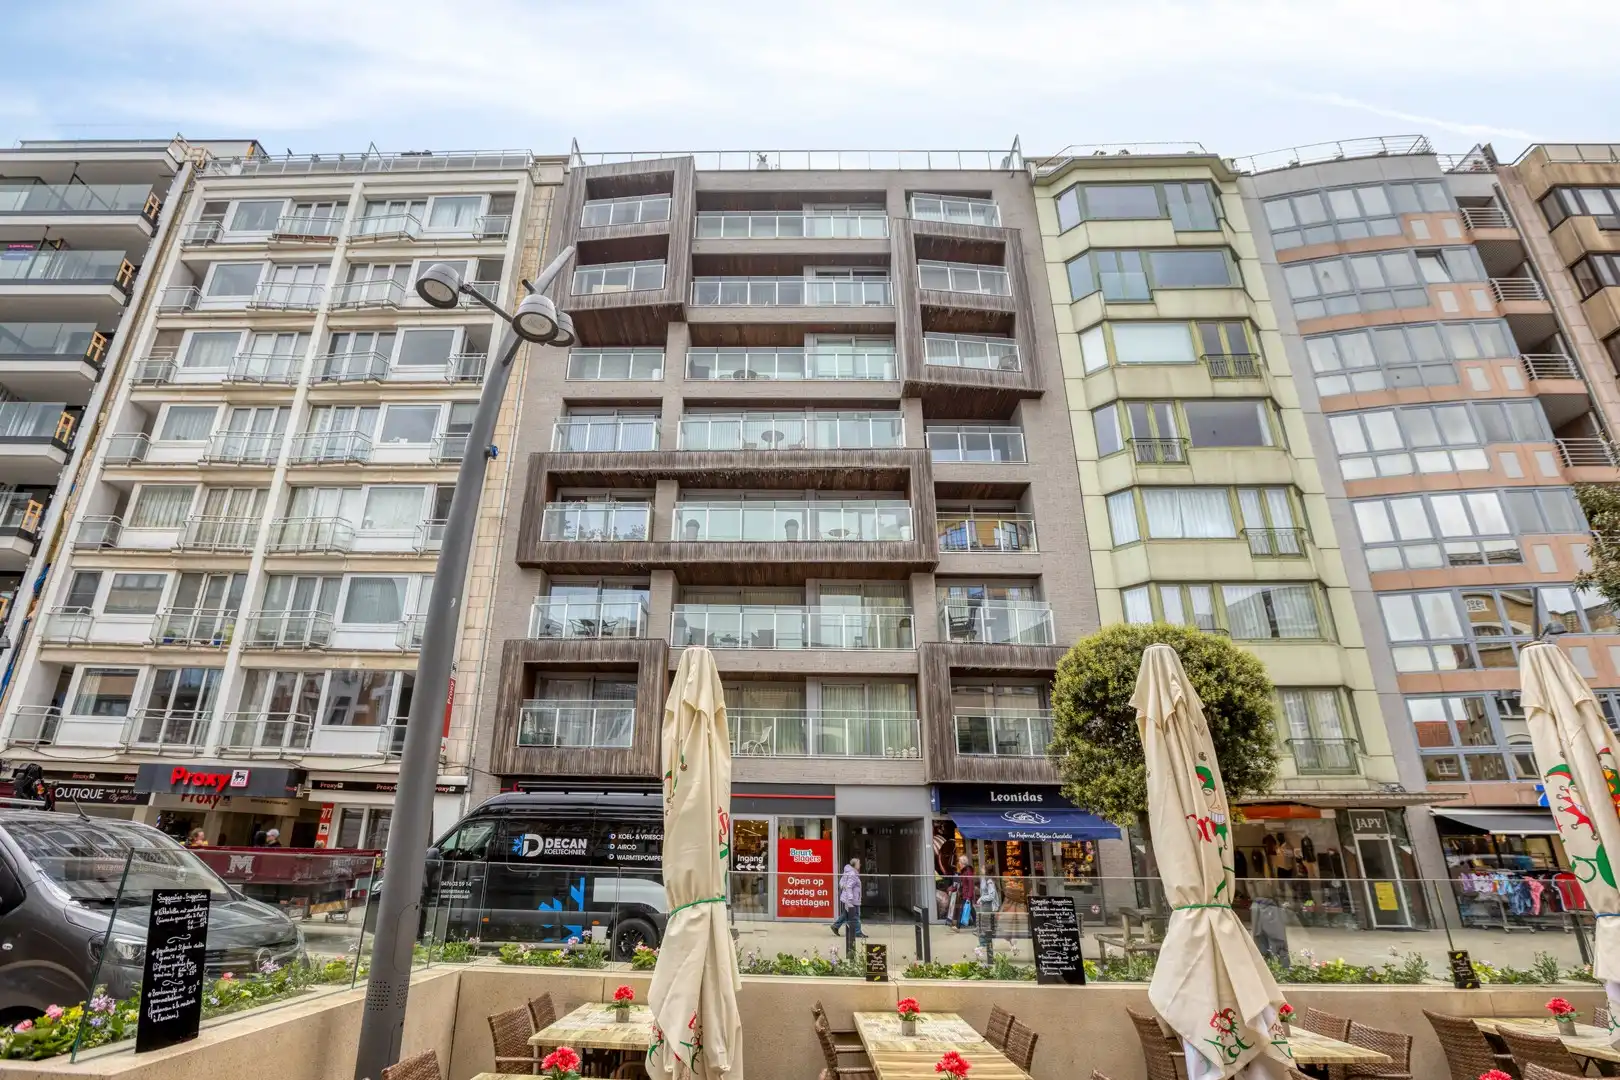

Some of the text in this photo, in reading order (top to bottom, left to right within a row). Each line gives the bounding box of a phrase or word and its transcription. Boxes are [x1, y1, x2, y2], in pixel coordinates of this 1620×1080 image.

[170, 766, 232, 792] Proxy
[320, 781, 338, 789] Proxy
[55, 787, 105, 799] OUTIQUE
[990, 791, 1043, 802] Leonidas
[1355, 818, 1382, 831] JAPY
[545, 838, 588, 849] DECAN
[544, 848, 586, 856] KOELTECHNIEK
[790, 848, 812, 857] Buurt
[737, 855, 764, 864] Ingang
[794, 855, 821, 863] slagers
[787, 877, 824, 887] Open op
[783, 888, 815, 897] zondag
[782, 898, 830, 908] feestdagen
